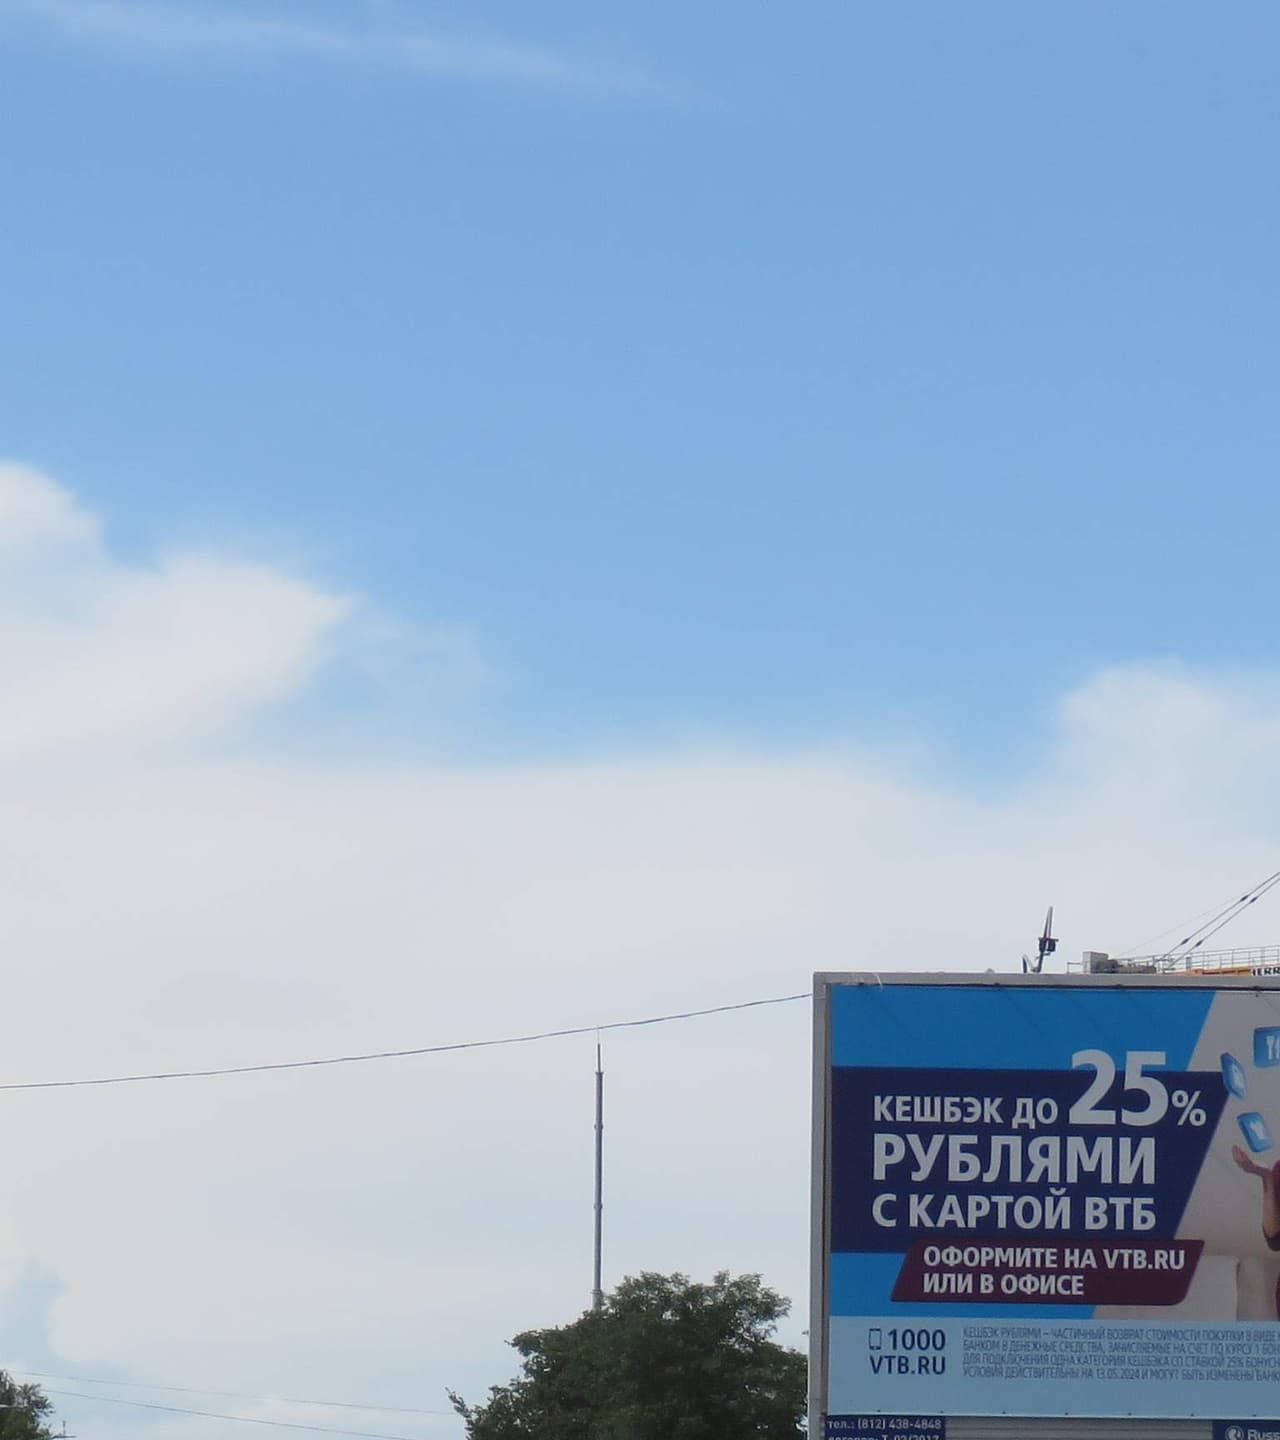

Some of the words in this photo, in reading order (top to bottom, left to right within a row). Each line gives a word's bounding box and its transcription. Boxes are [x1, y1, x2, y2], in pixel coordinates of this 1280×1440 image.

[873, 1094, 1004, 1124] КЕШБЭК
[1011, 1097, 1058, 1130] ДО
[1069, 1049, 1206, 1127] 25%
[872, 1133, 1156, 1185] РУБЛЯМИ
[872, 1193, 897, 1228] С
[909, 1187, 1071, 1230] КАРТОЙ
[1084, 1197, 1156, 1231] ВТБ
[923, 1246, 1058, 1270] ОФОРМИТЕ
[1065, 1248, 1097, 1270] НА
[1104, 1249, 1185, 1271] VTB.RU
[923, 1273, 973, 1294] ИЛИ
[980, 1274, 993, 1295] В
[1000, 1273, 1084, 1296] ОФИСЕ
[887, 1328, 946, 1351] 1000
[869, 1355, 946, 1375] VTB.RU
[857, 1418, 886, 1430] (812)
[888, 1418, 941, 1430] 438-4848
[1247, 1429, 1280, 1440] Russ
